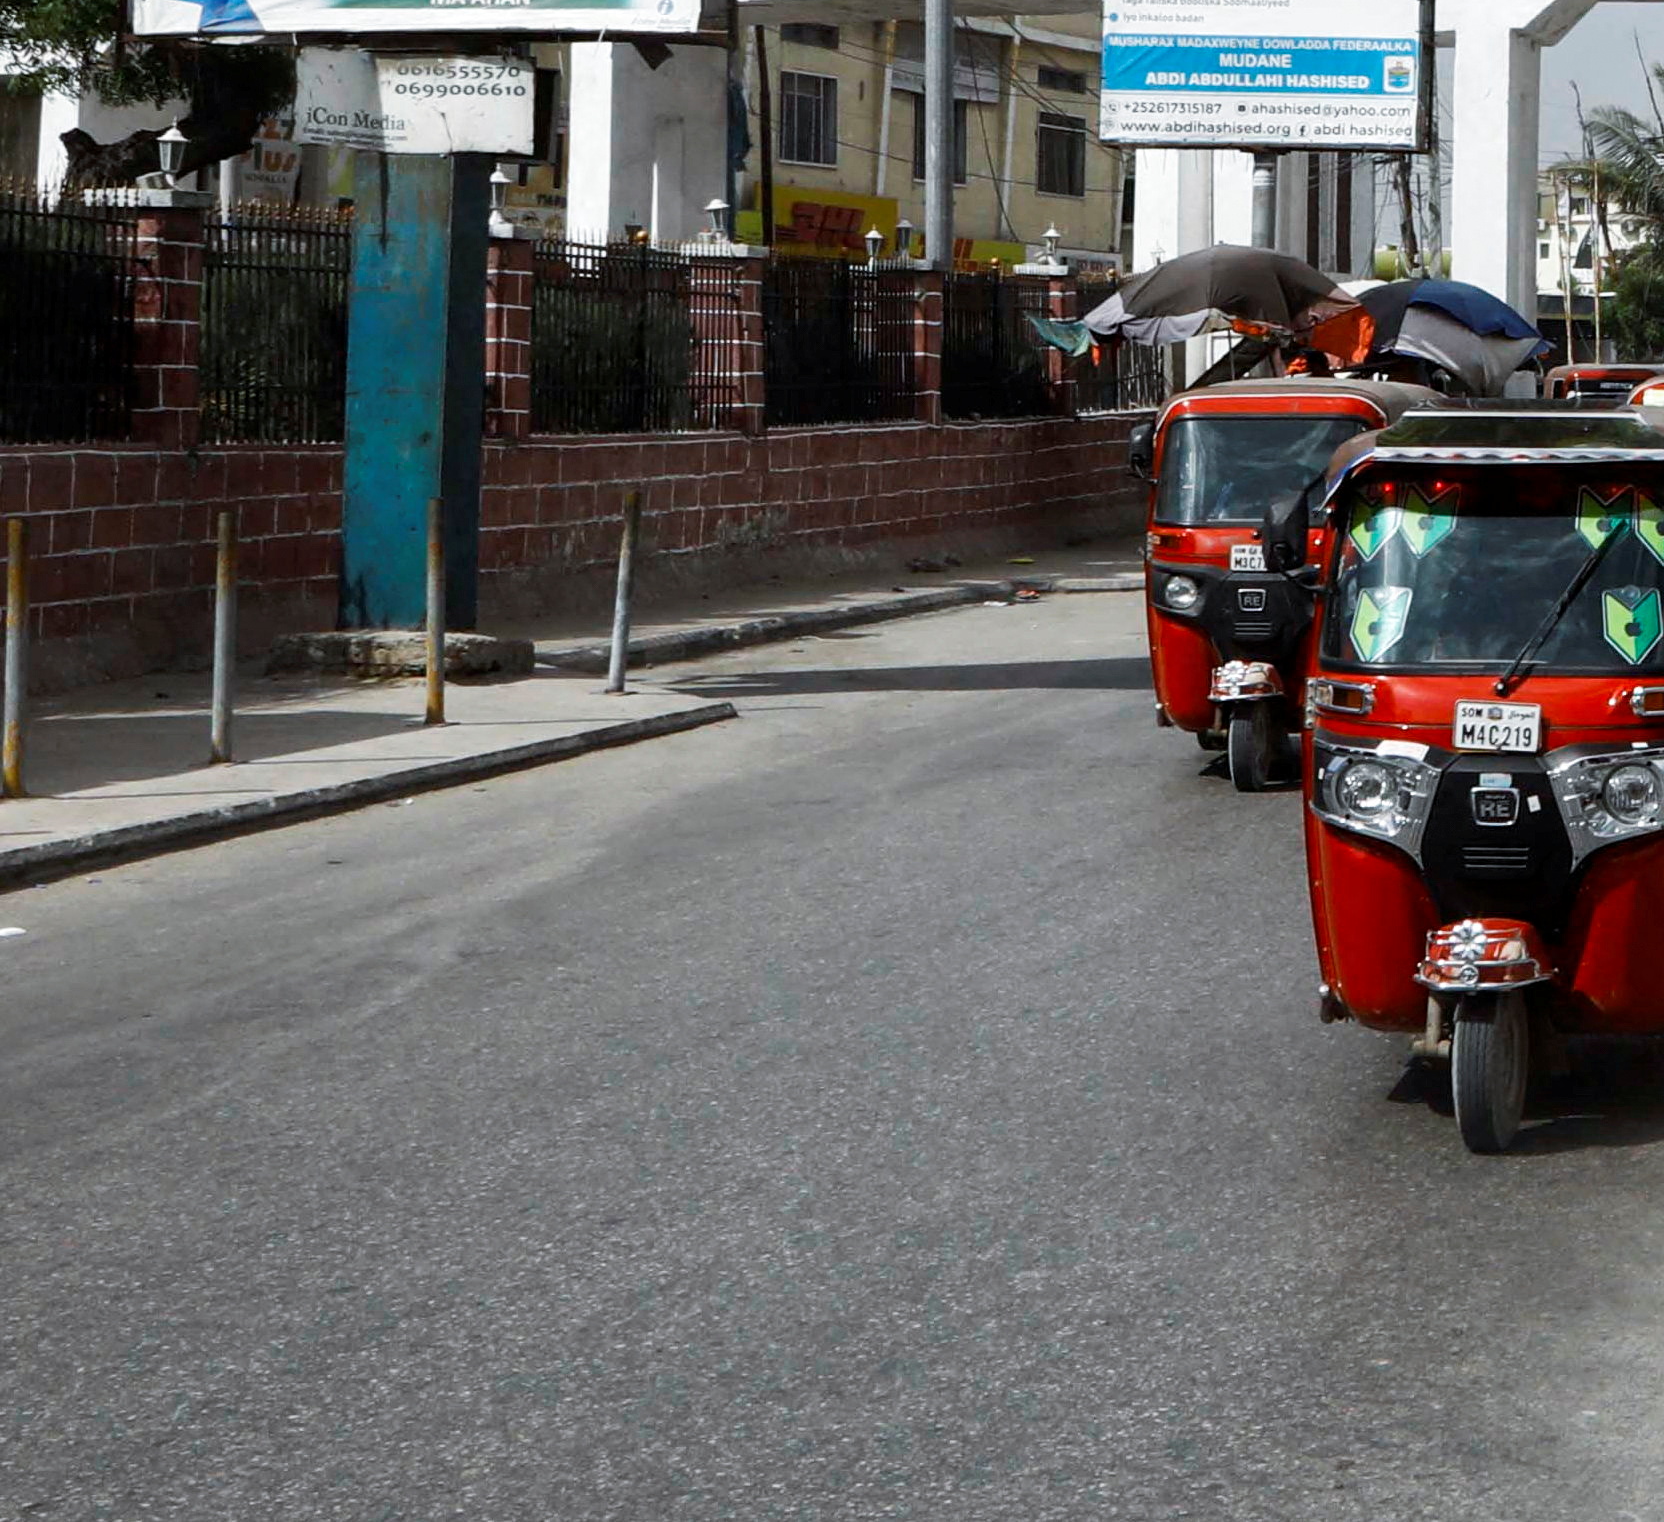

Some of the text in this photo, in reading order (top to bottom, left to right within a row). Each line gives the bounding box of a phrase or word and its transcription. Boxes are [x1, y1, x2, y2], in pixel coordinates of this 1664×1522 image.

[1109, 36, 1174, 47] MUSHARAX
[1177, 37, 1261, 49] MADAXWEYNE
[1332, 39, 1411, 52] FEDERAALKA
[1219, 54, 1292, 68] MUDANE
[1145, 72, 1370, 89] ABDI ABDULLAHI HASHISED
[395, 83, 526, 98] 0699006610
[306, 107, 405, 130] iCon Media
[1251, 104, 1410, 118] ahashised@yahoo.com
[1120, 121, 1412, 137] www.abdihashised.org abdi hashised
[1244, 596, 1261, 606] RE
[1461, 708, 1483, 717] SOM
[1462, 724, 1532, 747] M4C219
[1480, 800, 1511, 818] RE
